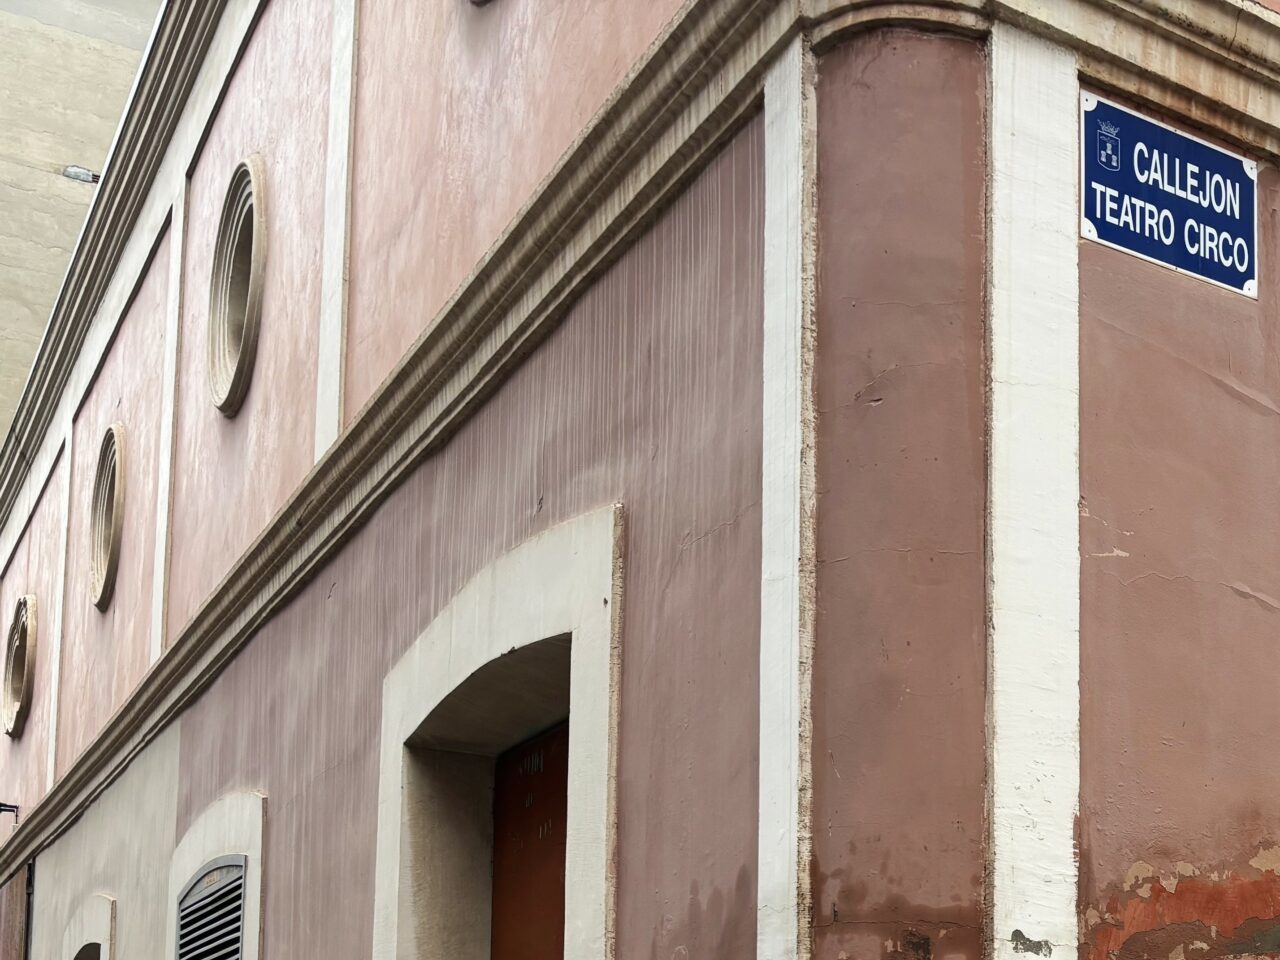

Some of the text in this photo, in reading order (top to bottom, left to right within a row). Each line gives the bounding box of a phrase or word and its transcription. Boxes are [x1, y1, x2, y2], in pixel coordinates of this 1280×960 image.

[1133, 141, 1240, 220] CALLEJON
[1091, 181, 1249, 273] TEATRO CIRCO
